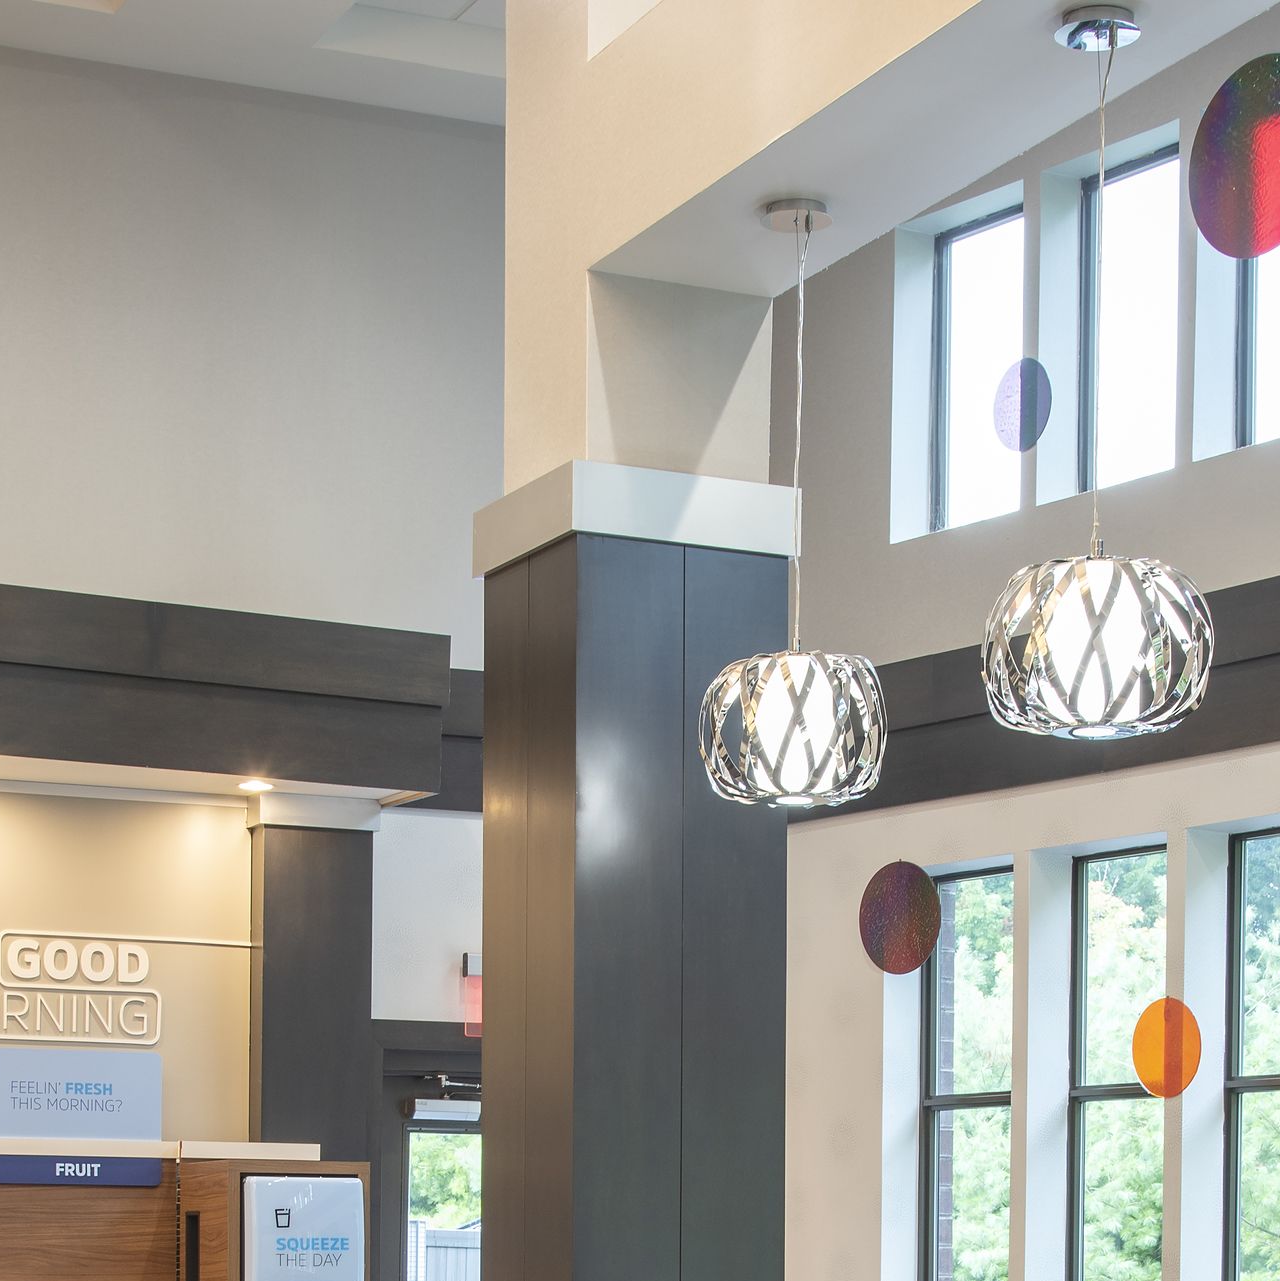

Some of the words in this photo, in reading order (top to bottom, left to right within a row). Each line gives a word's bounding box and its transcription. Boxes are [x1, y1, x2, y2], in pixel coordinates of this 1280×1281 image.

[7, 939, 150, 983] GOOD
[65, 1082, 113, 1096] FRESH
[10, 1096, 41, 1111] THIS
[47, 1098, 123, 1113] MORNING?
[55, 1163, 101, 1177] FRUIT
[276, 1237, 350, 1252] SQUEEZE
[276, 1253, 308, 1267] THE
[312, 1253, 342, 1267] DAY
